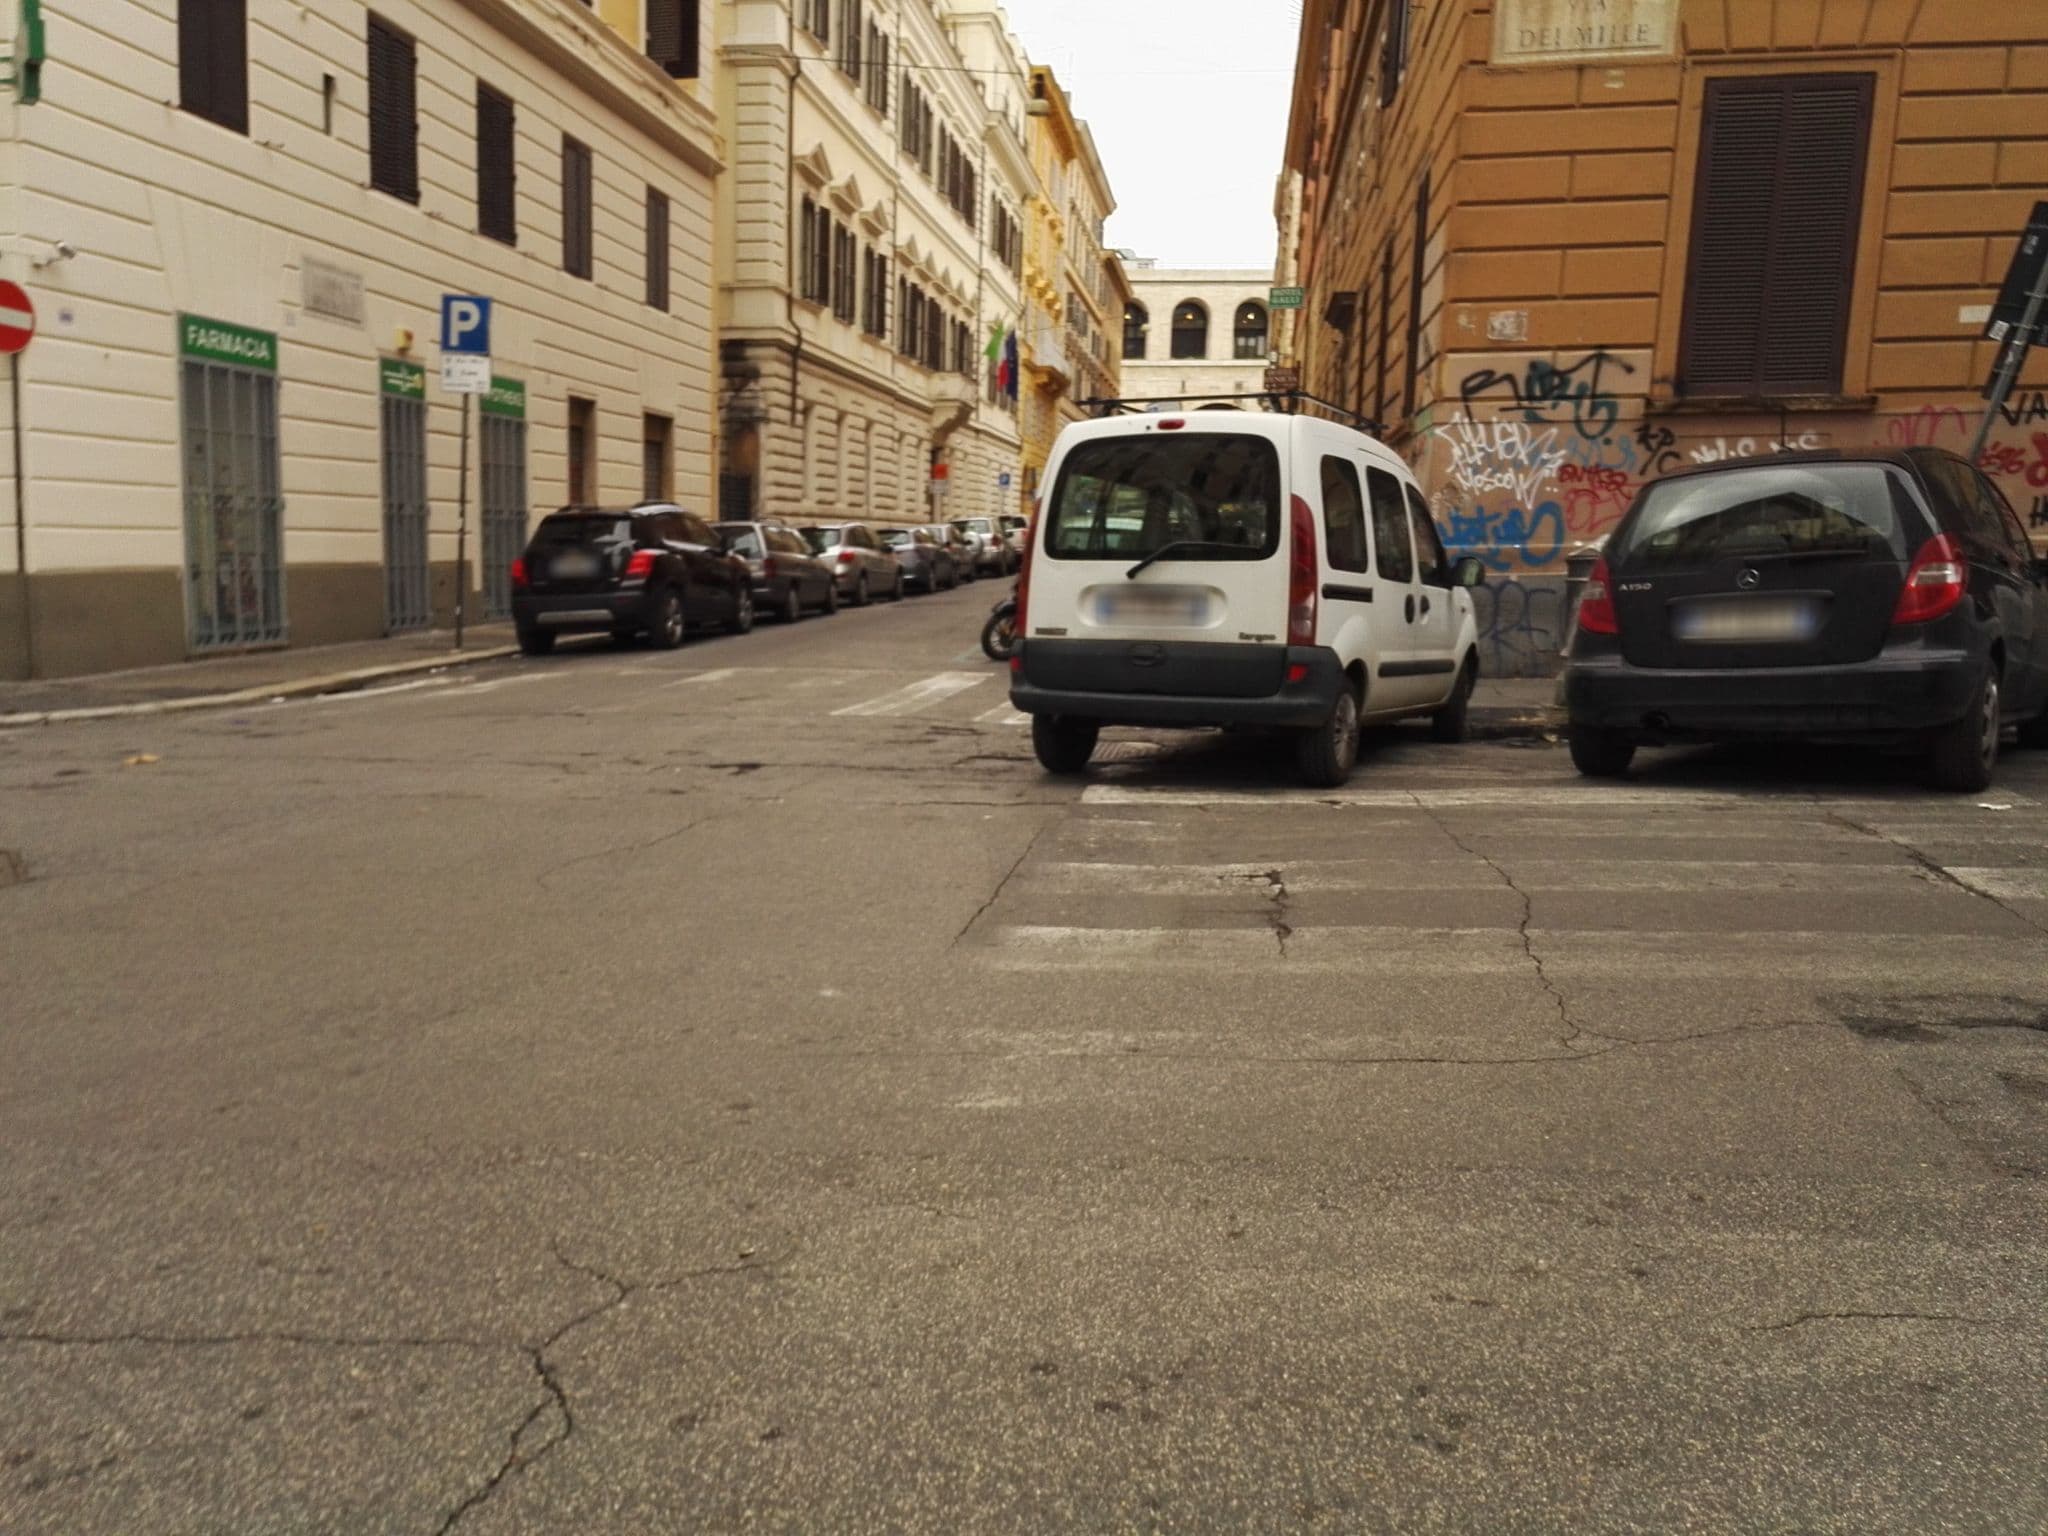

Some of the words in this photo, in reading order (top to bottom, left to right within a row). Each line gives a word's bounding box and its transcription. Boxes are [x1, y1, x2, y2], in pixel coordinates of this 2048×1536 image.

[1576, 24, 1649, 46] MILLE
[449, 300, 481, 347] P
[187, 324, 271, 361] FARMACIA
